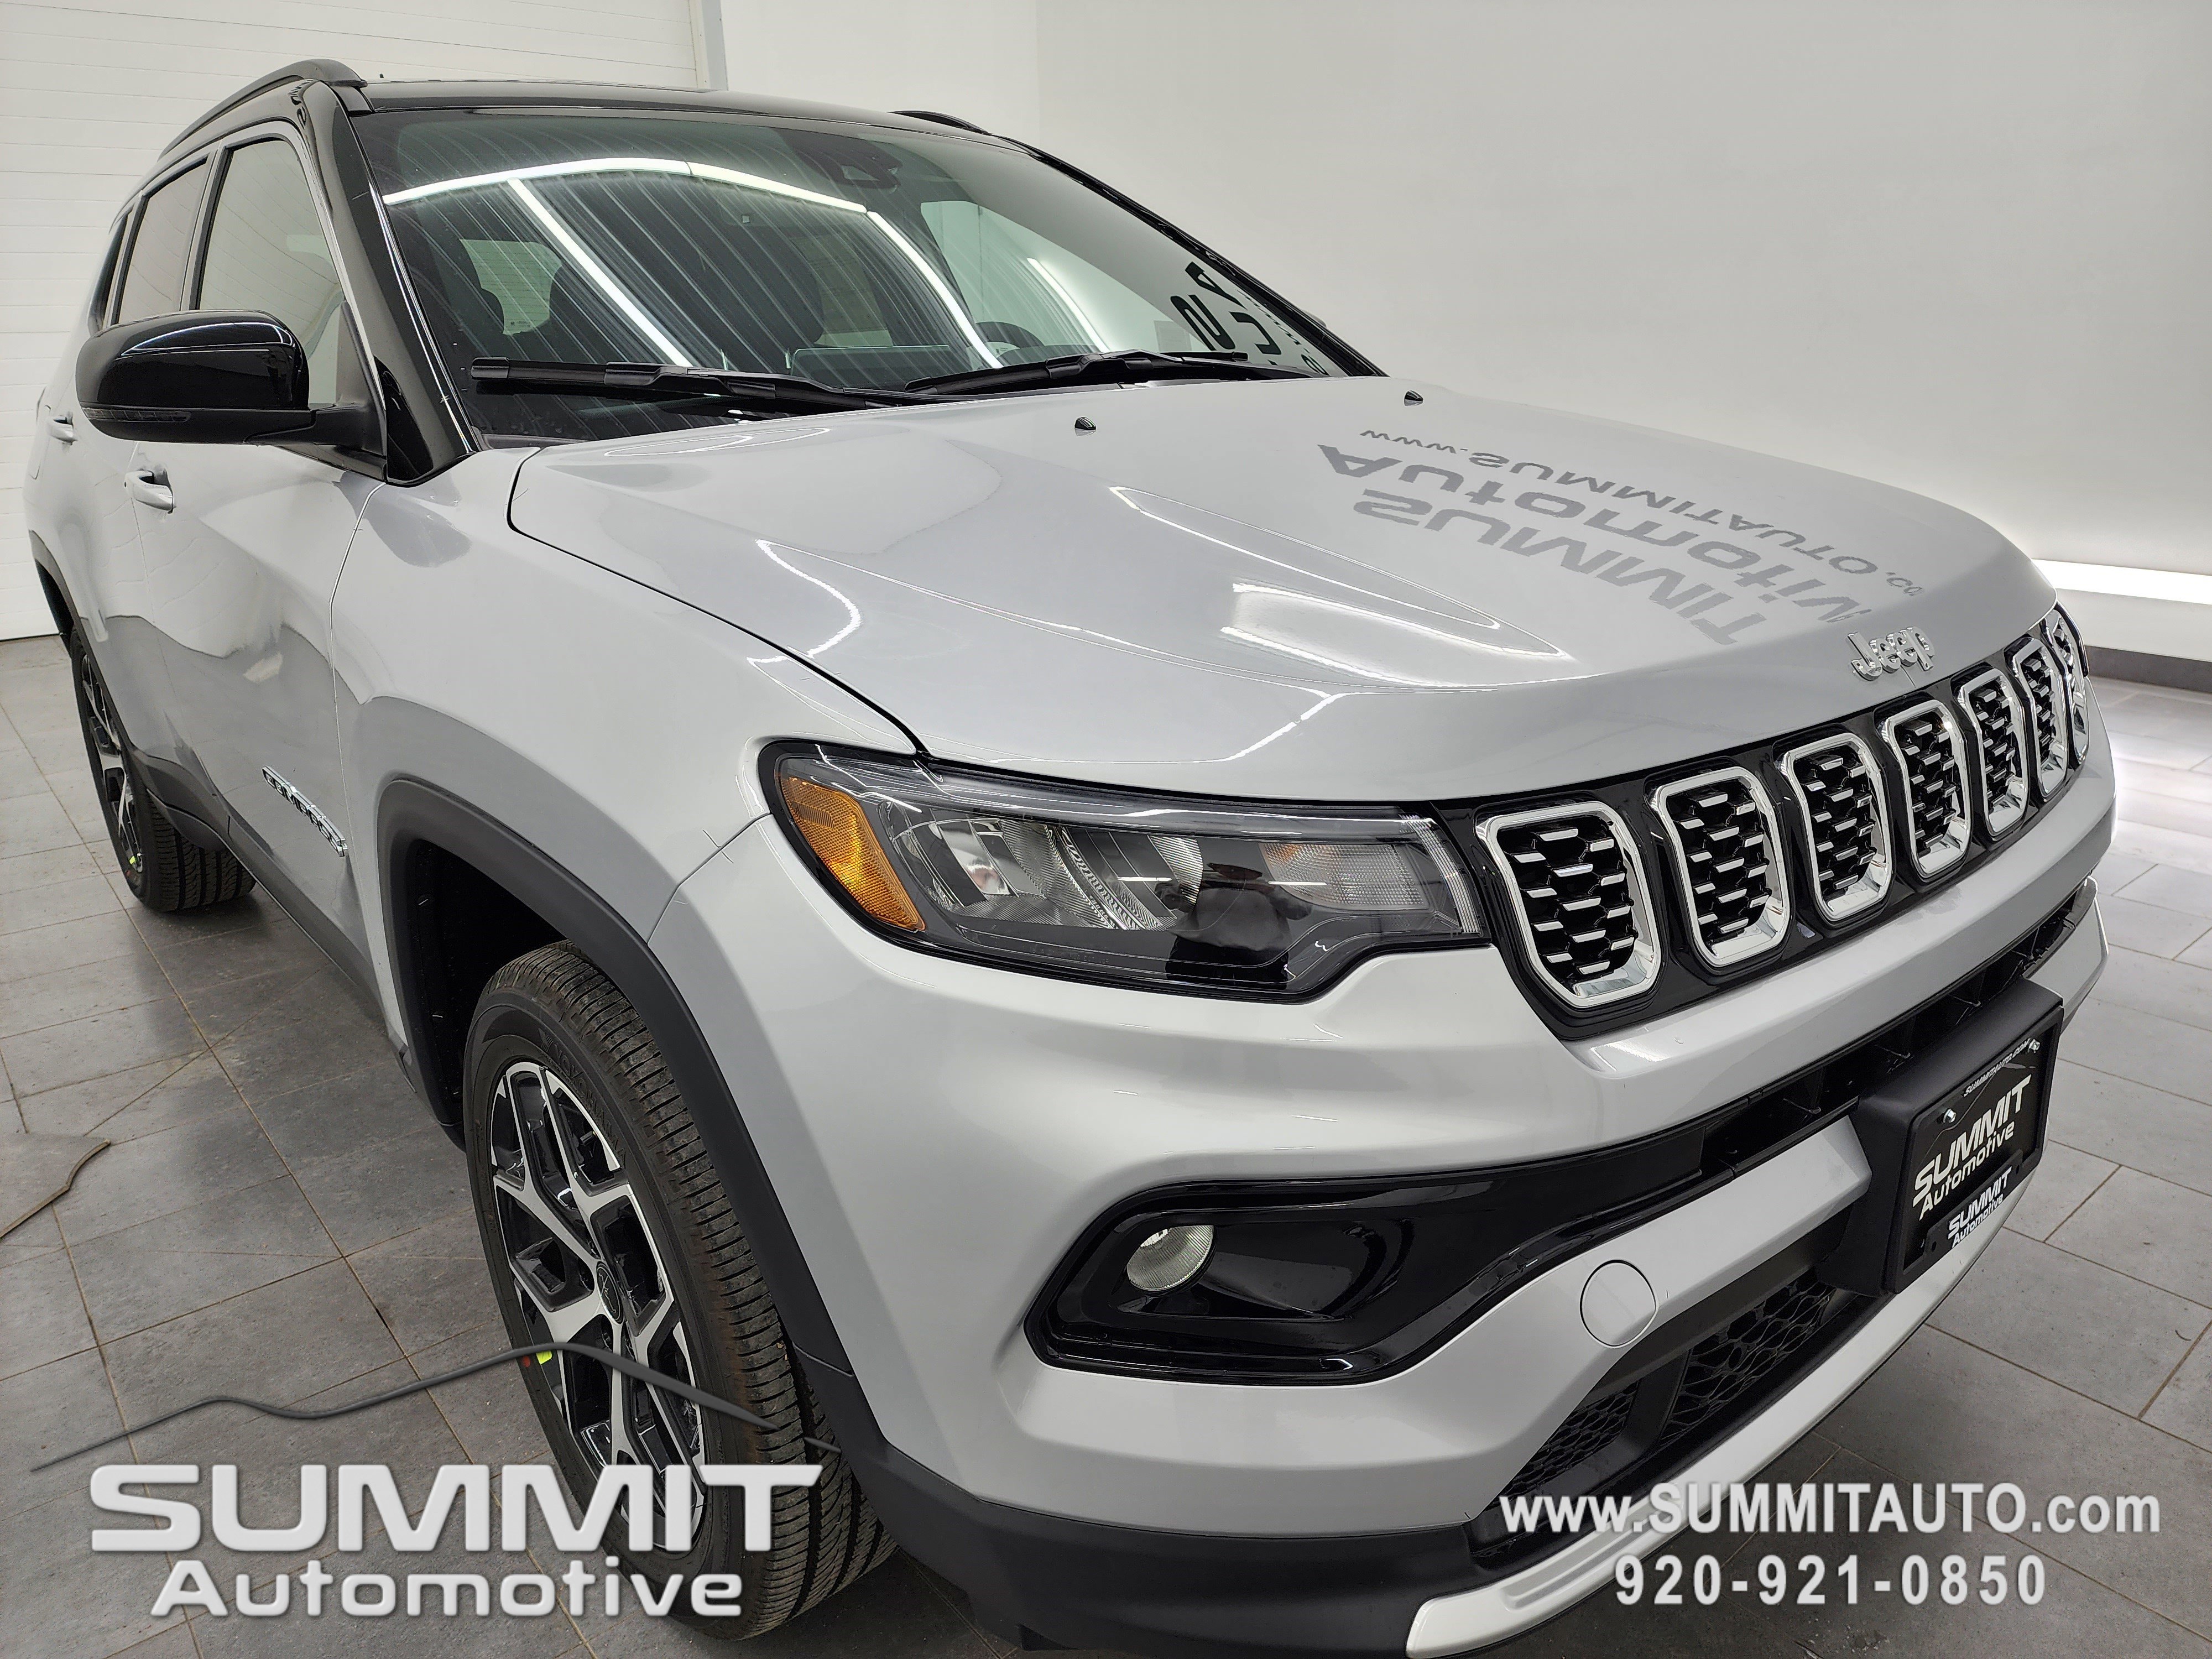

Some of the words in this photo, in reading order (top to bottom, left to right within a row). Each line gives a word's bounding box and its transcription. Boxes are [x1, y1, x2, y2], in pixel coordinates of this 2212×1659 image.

[1847, 626, 1935, 681] Jeep
[1913, 1074, 2032, 1207] SUMMIT
[1919, 1121, 2015, 1221] Automotive
[1948, 1166, 2012, 1239] SUMMIT
[1952, 1194, 2004, 1248] Automotive
